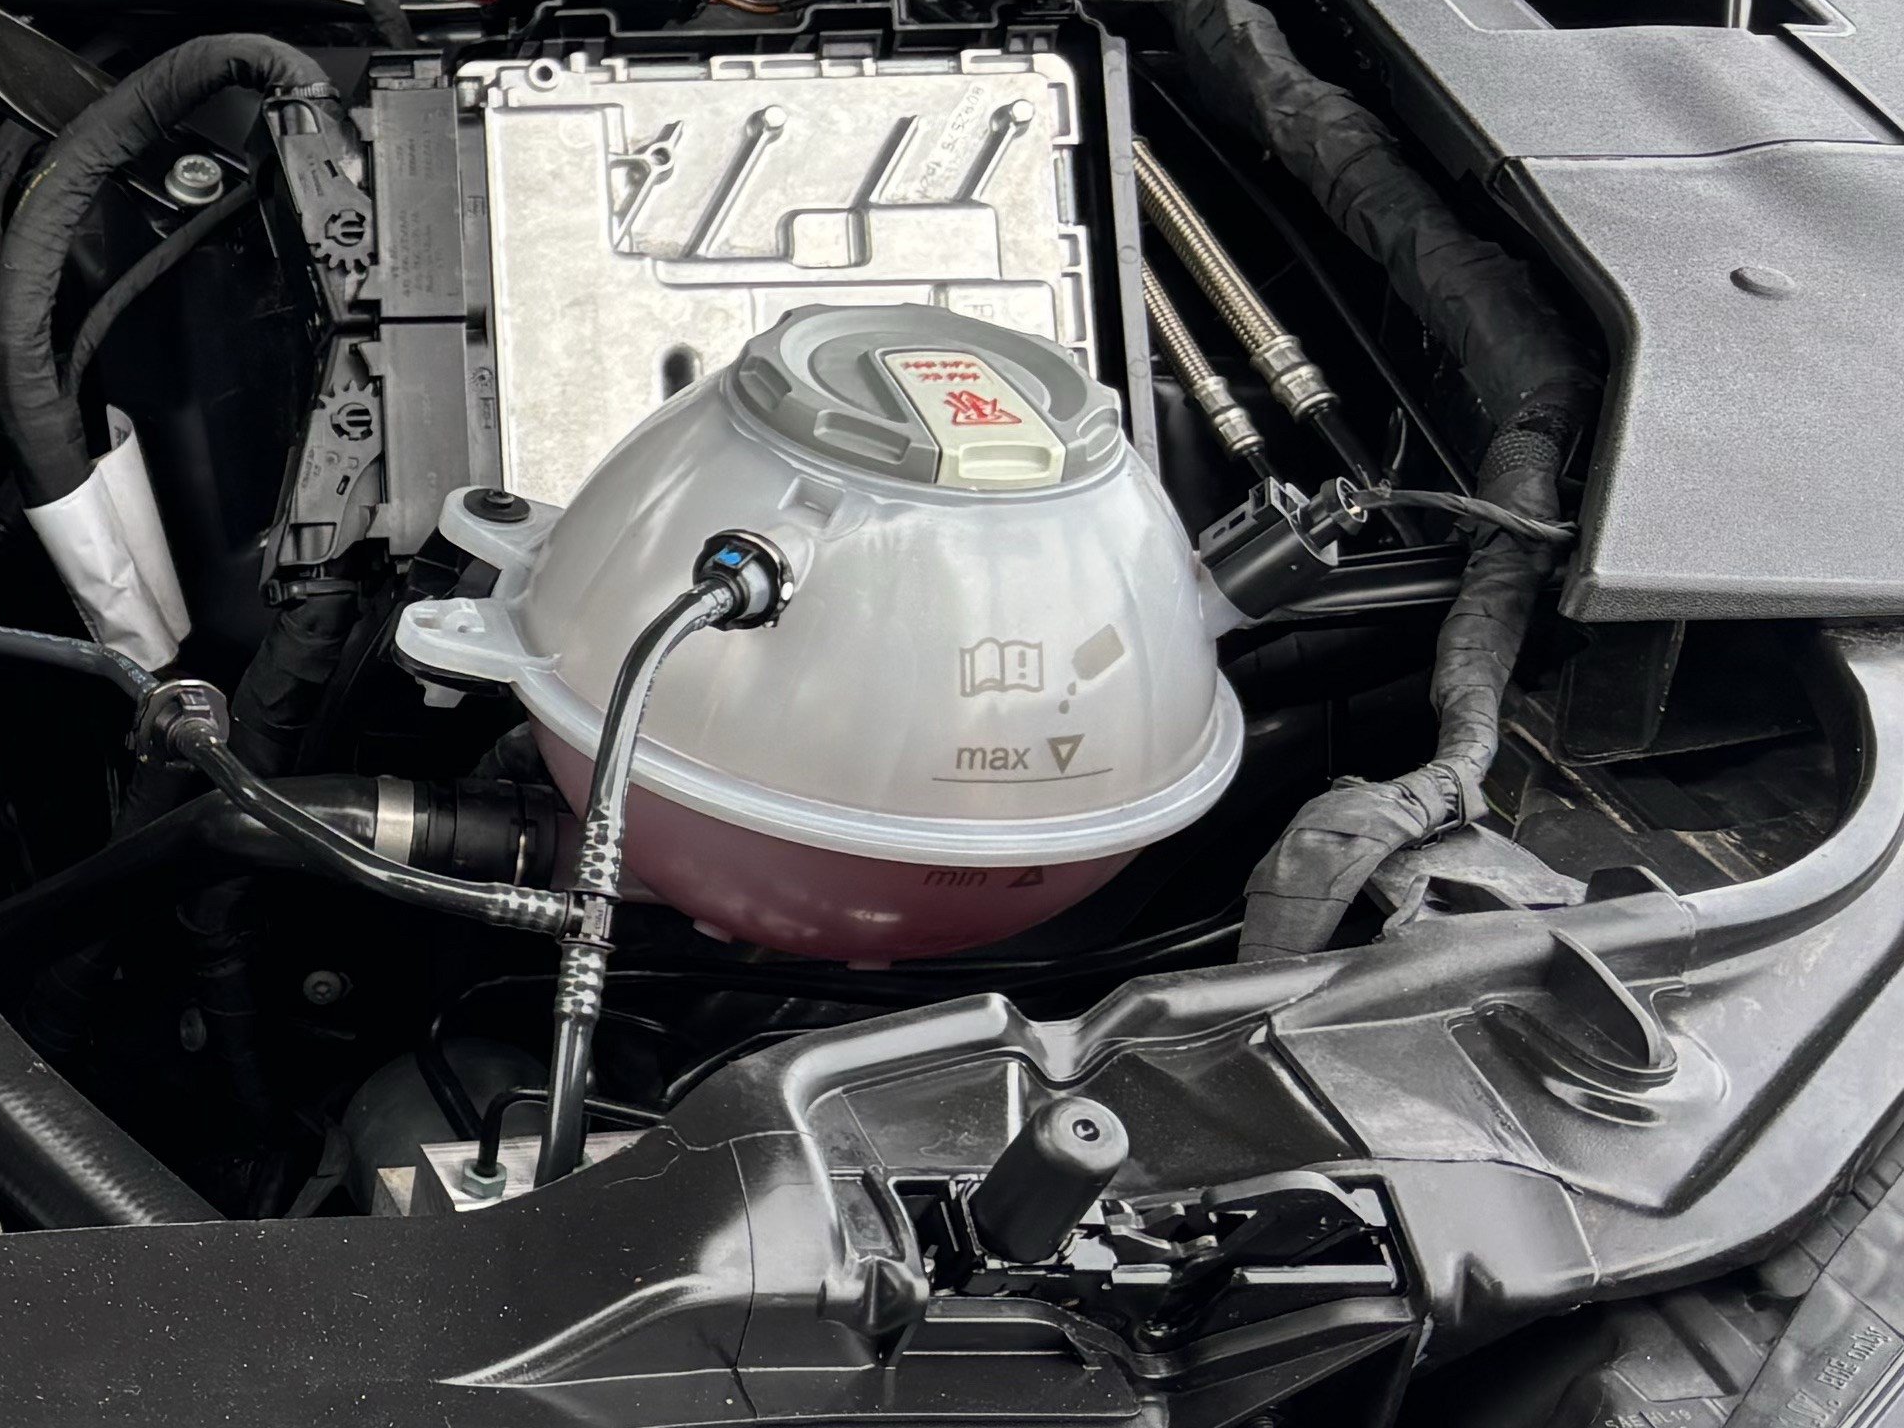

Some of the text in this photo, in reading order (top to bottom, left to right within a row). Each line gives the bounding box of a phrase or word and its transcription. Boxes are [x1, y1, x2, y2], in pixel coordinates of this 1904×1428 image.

[955, 747, 1031, 771] max
[922, 869, 987, 887] min
[1846, 1326, 1892, 1361] only
